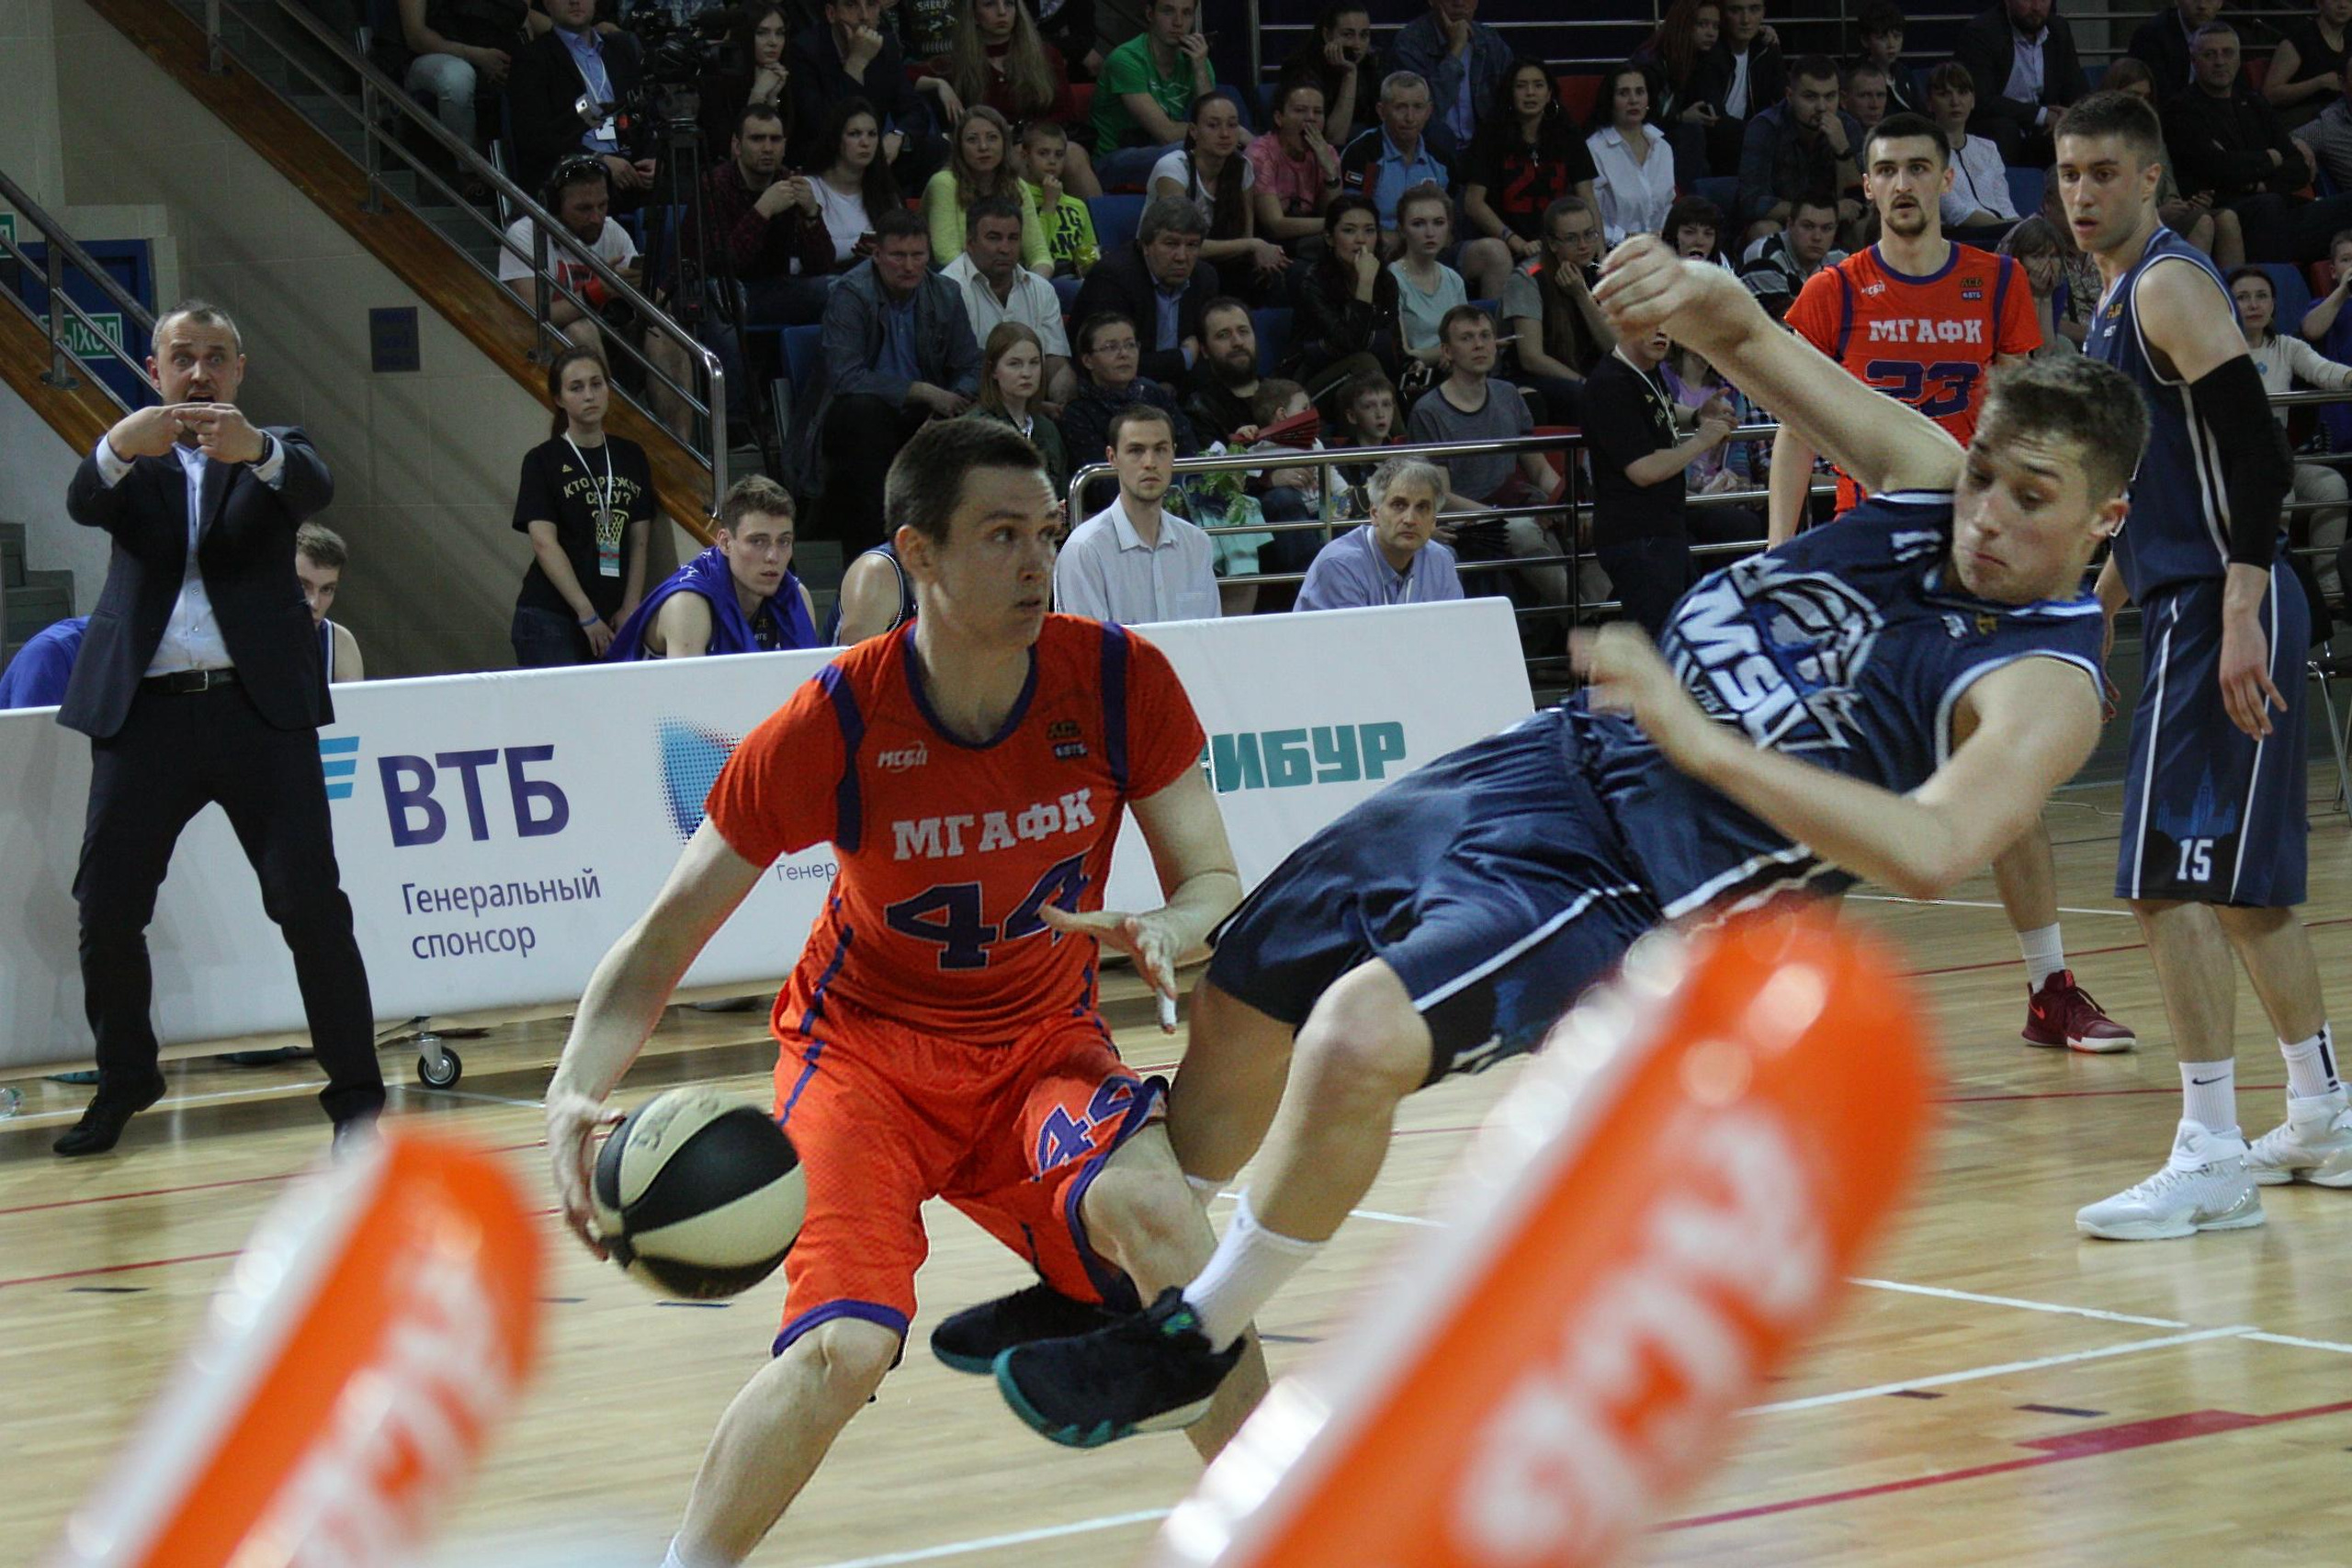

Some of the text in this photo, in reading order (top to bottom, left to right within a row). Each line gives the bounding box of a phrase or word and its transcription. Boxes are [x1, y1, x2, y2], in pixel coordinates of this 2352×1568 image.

[1503, 154, 1568, 213] 23
[1869, 319, 1983, 344] МГАФК
[1866, 359, 1982, 418] 23
[562, 477, 590, 499] КТО
[1677, 577, 1808, 750] MSU
[1201, 721, 1407, 794] ИБУР
[378, 744, 570, 847] ВТБ
[892, 787, 1095, 861] МГАФК
[776, 862, 838, 882] Генер
[2177, 839, 2214, 881] 15
[401, 868, 601, 918] Генеральный
[885, 847, 1091, 971] 44
[412, 925, 536, 958] спонсор
